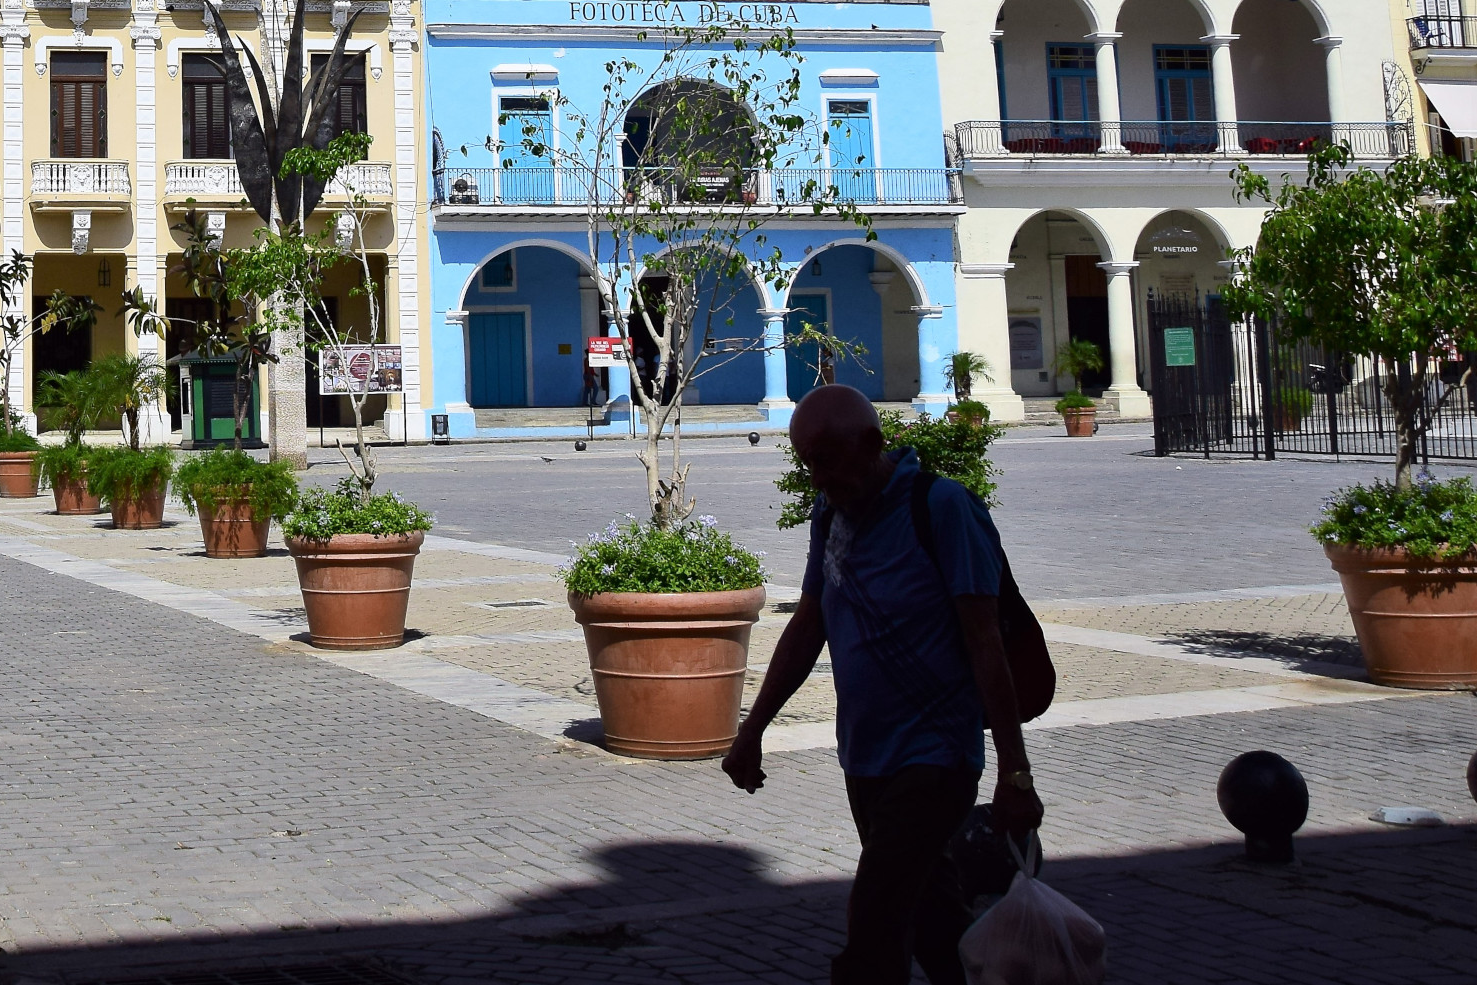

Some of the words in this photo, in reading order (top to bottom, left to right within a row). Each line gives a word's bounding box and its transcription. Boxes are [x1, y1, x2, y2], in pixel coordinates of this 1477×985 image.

[569, 1, 685, 22] FOTOTECA
[698, 3, 726, 23] DE
[740, 4, 800, 24] CUBA
